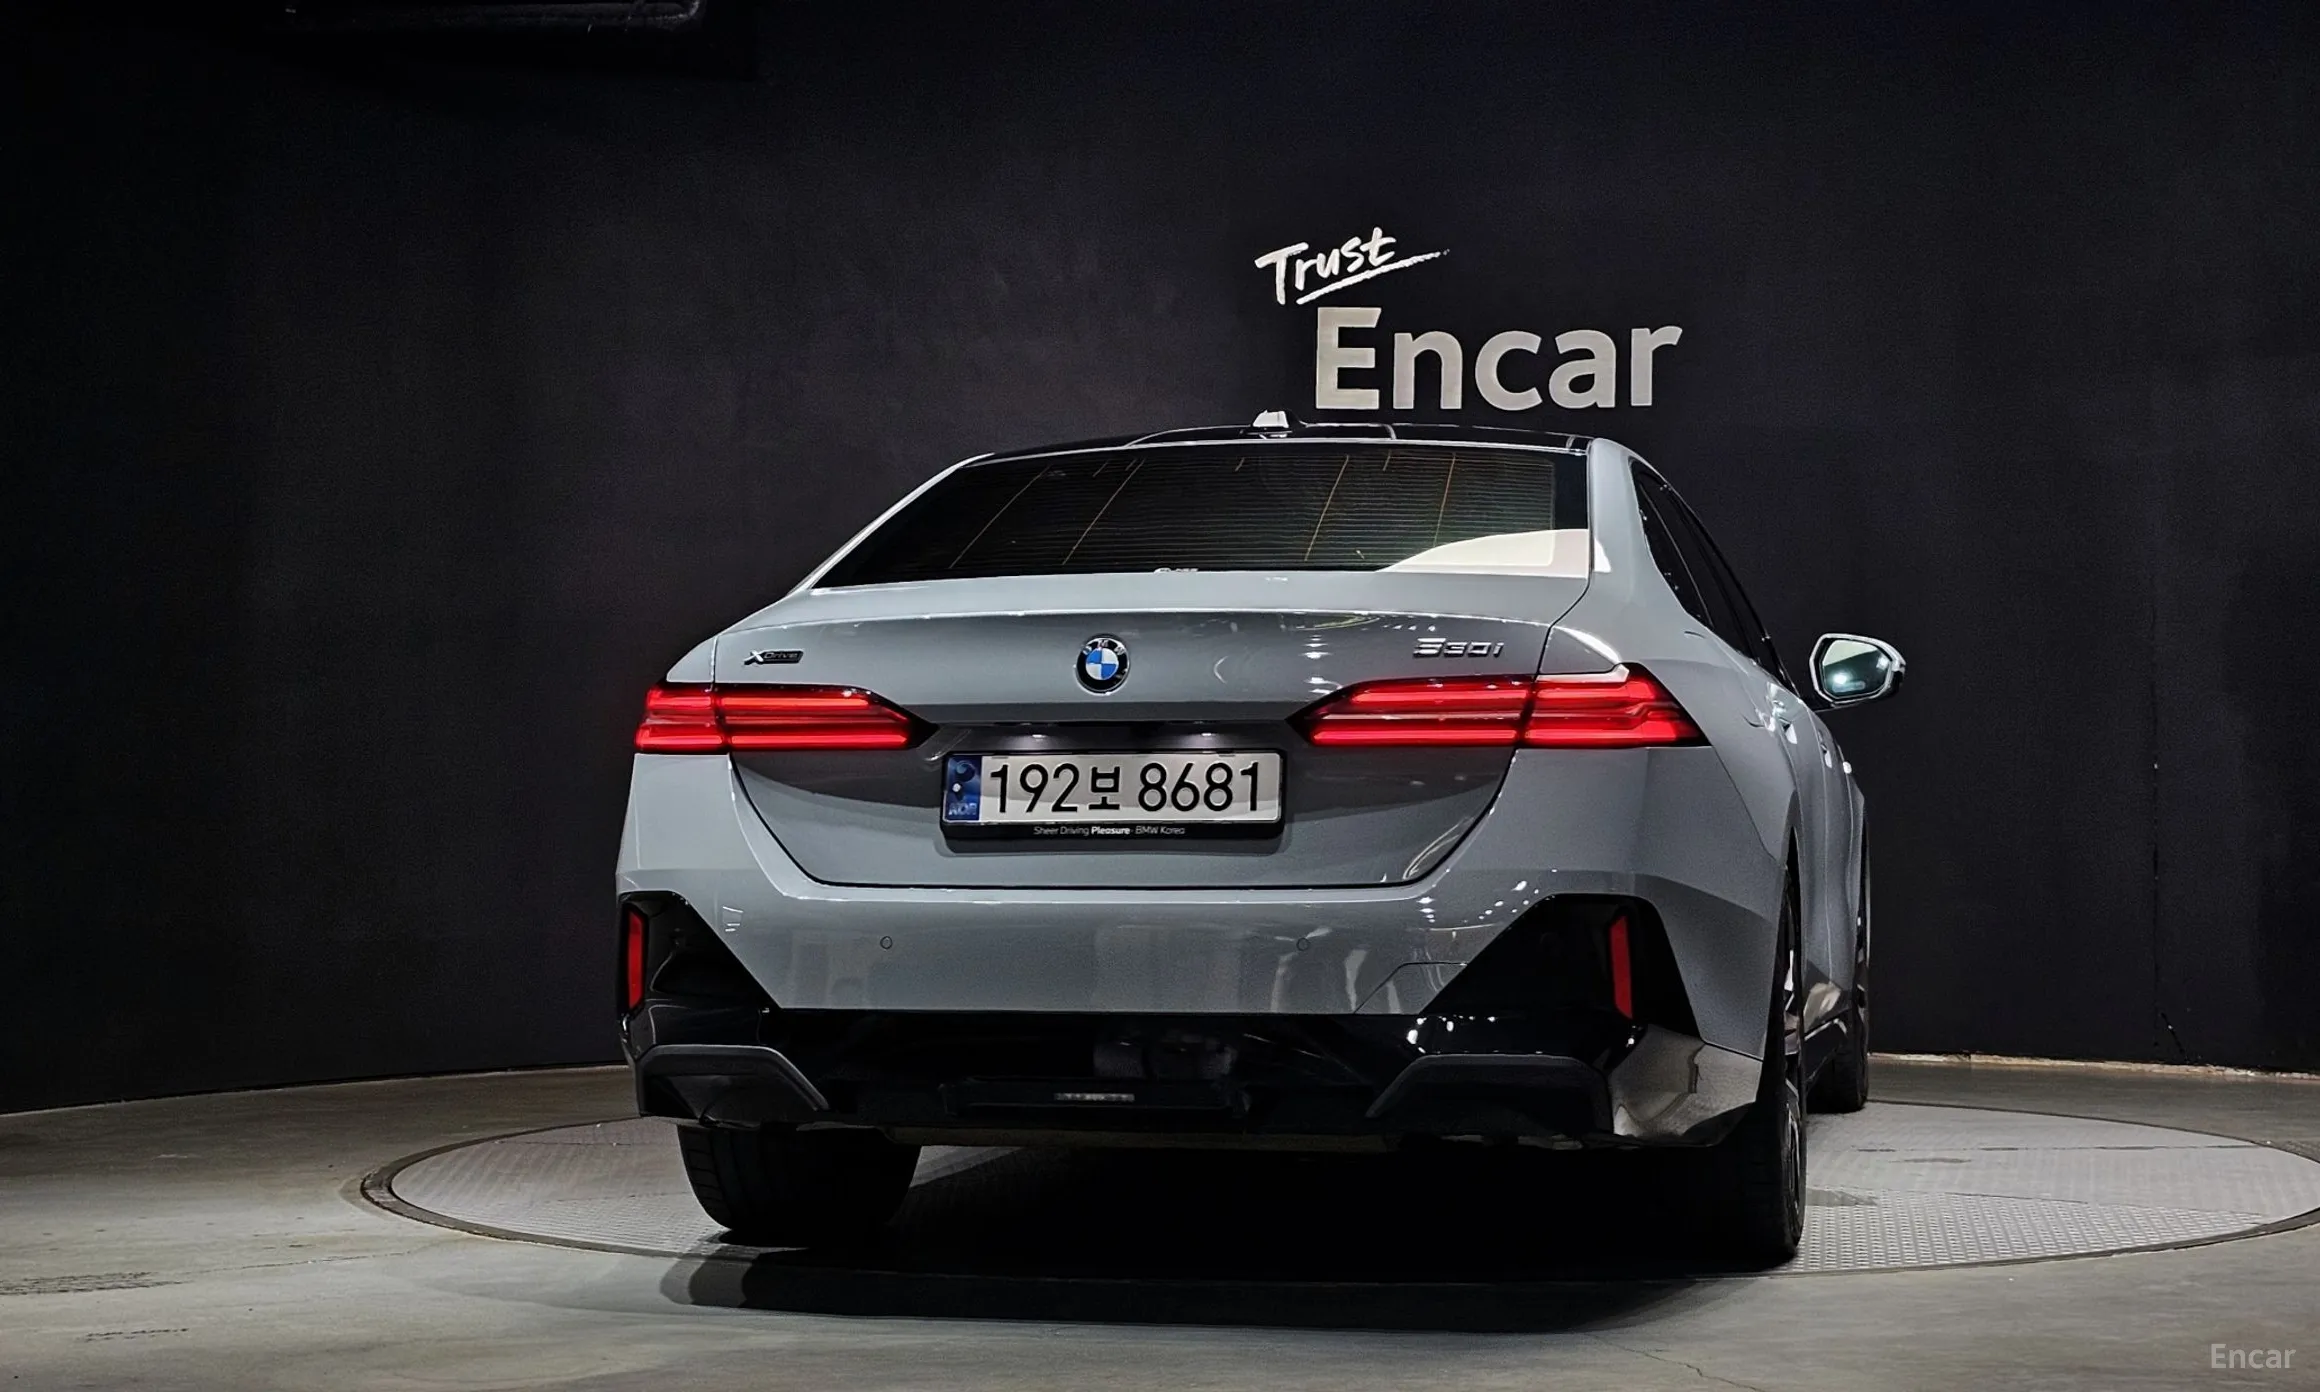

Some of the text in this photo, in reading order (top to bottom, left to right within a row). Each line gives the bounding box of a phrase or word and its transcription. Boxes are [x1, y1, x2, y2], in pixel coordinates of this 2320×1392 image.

[1255, 227, 1397, 305] Trust
[1316, 306, 1683, 411] Encar
[1081, 639, 1126, 656] BMW
[990, 762, 1260, 813] 192보 8681
[1033, 826, 1185, 837] Sheer Driving Pleasure BMW Korea
